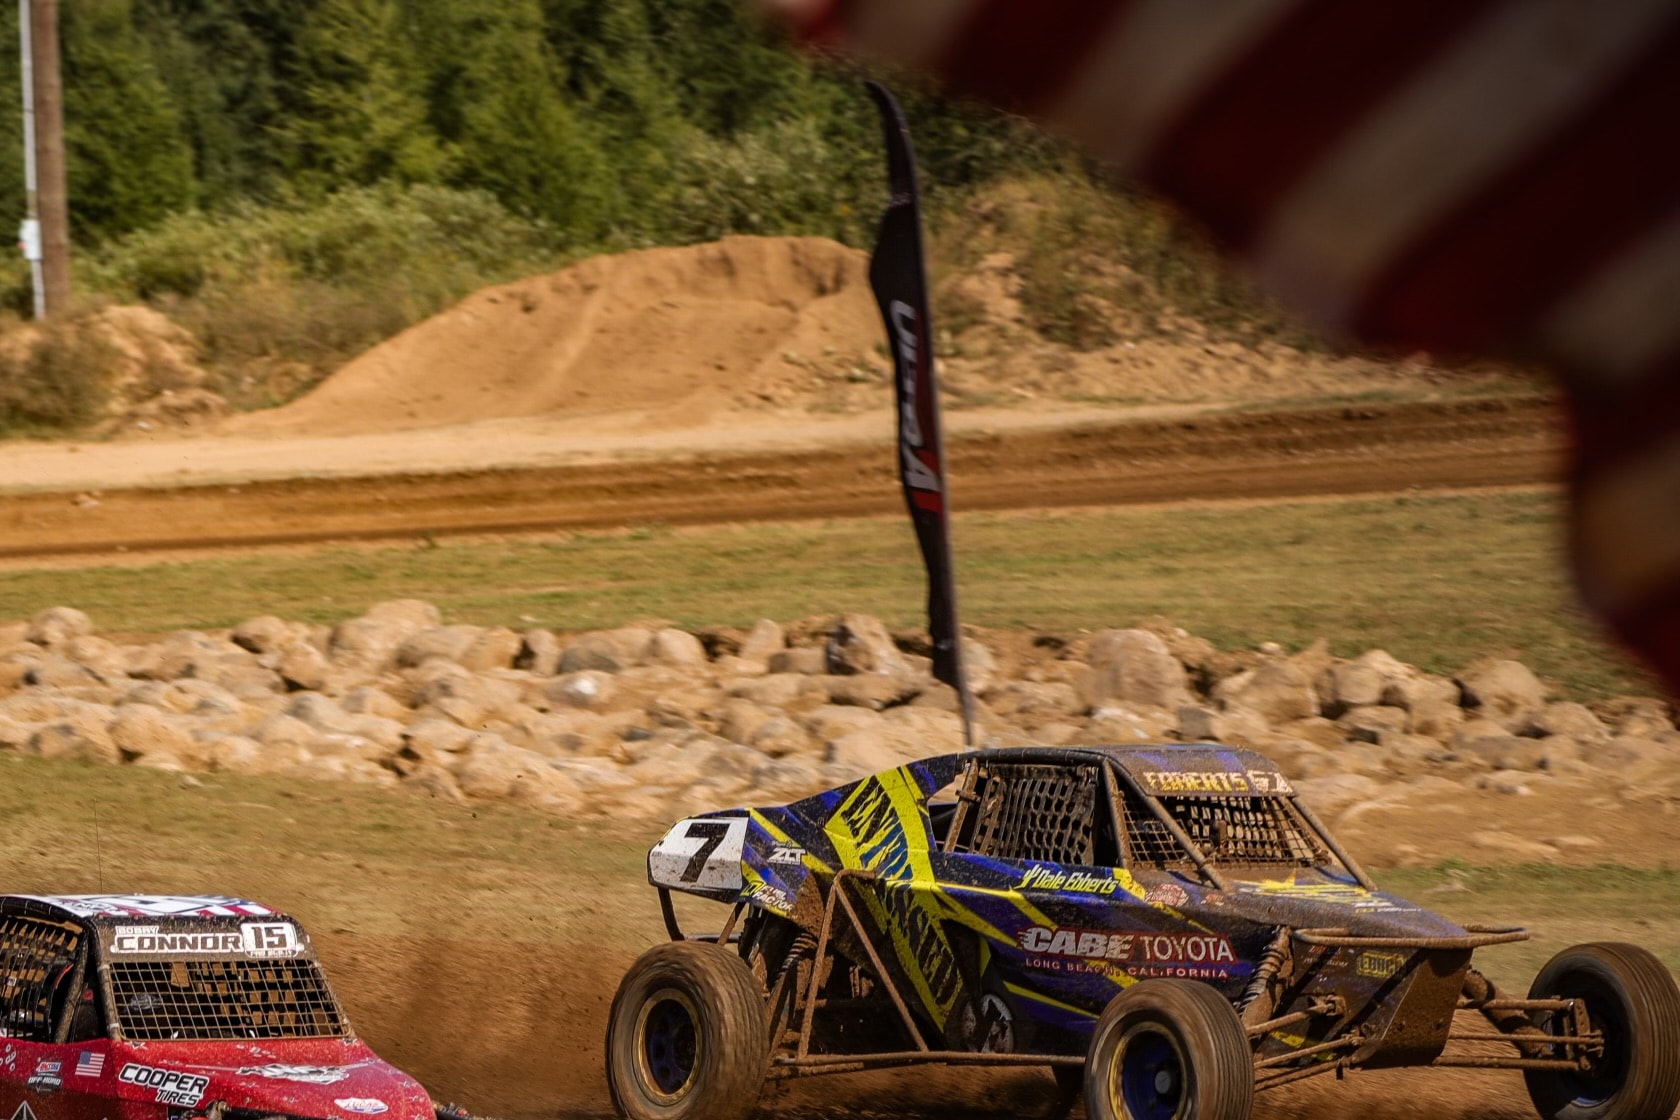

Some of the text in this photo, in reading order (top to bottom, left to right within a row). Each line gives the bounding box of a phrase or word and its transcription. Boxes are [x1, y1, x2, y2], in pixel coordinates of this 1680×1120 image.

[679, 822, 730, 882] 7
[1032, 869, 1119, 894] Dale Ebberts
[117, 926, 287, 951] CONNOR 15
[1018, 927, 1234, 961] CABE TOYOTA
[1025, 958, 1060, 970] LONG
[120, 1065, 209, 1094] COOPER
[157, 1089, 200, 1106] TIRES
